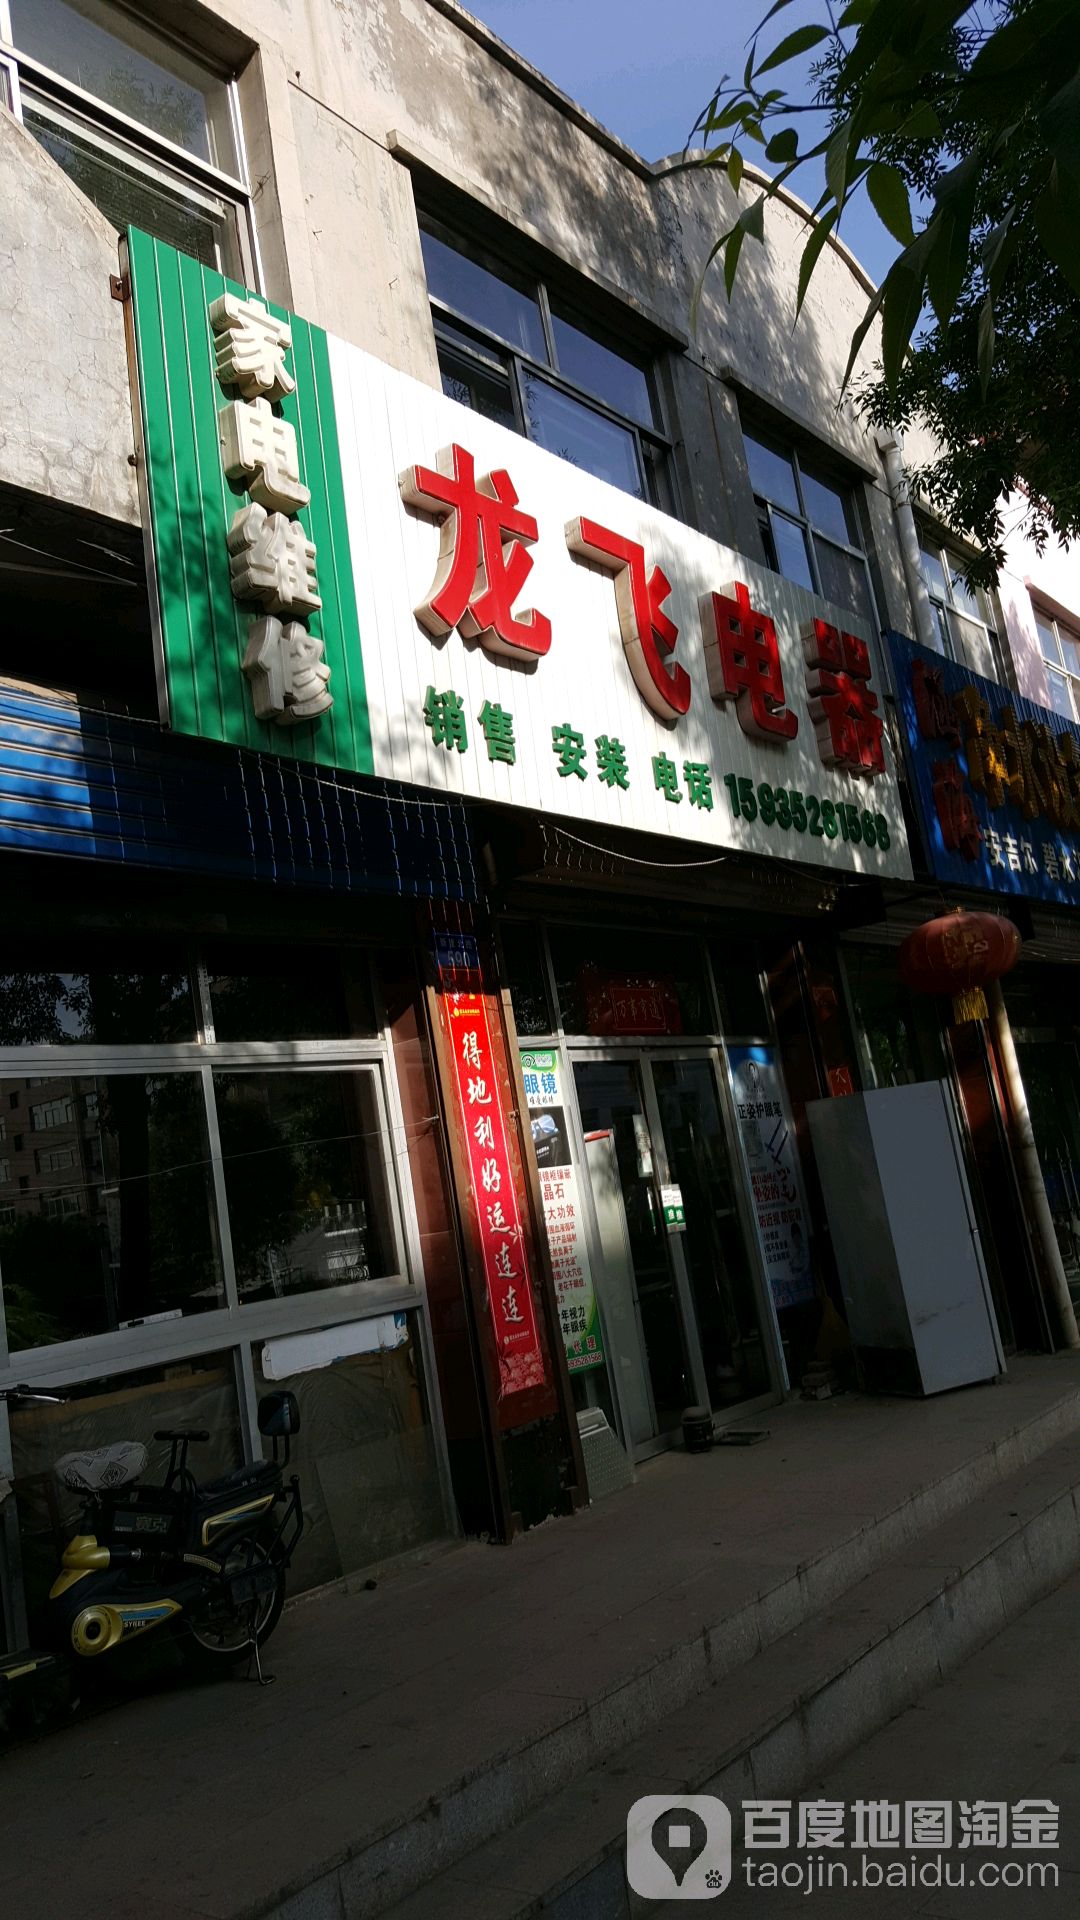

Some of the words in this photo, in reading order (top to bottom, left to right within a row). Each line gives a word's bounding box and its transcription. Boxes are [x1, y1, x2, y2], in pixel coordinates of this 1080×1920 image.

[209, 293, 334, 725] 家电维修
[400, 445, 886, 778] 龙飞电器
[423, 685, 517, 765] 销售
[552, 722, 630, 790] 安装
[651, 751, 714, 811] 电话
[724, 773, 890, 850] 15935281568
[983, 826, 1038, 875] 安吉尔
[524, 1073, 557, 1095] 眼镜
[737, 1101, 783, 1119] 正姿护眼笔
[462, 1032, 524, 1324] 得地利好运连连
[544, 1183, 564, 1201] 晶石
[544, 1203, 575, 1220] 大功效
[557, 1305, 586, 1322] 年视力
[560, 1318, 587, 1336] 年眼疾
